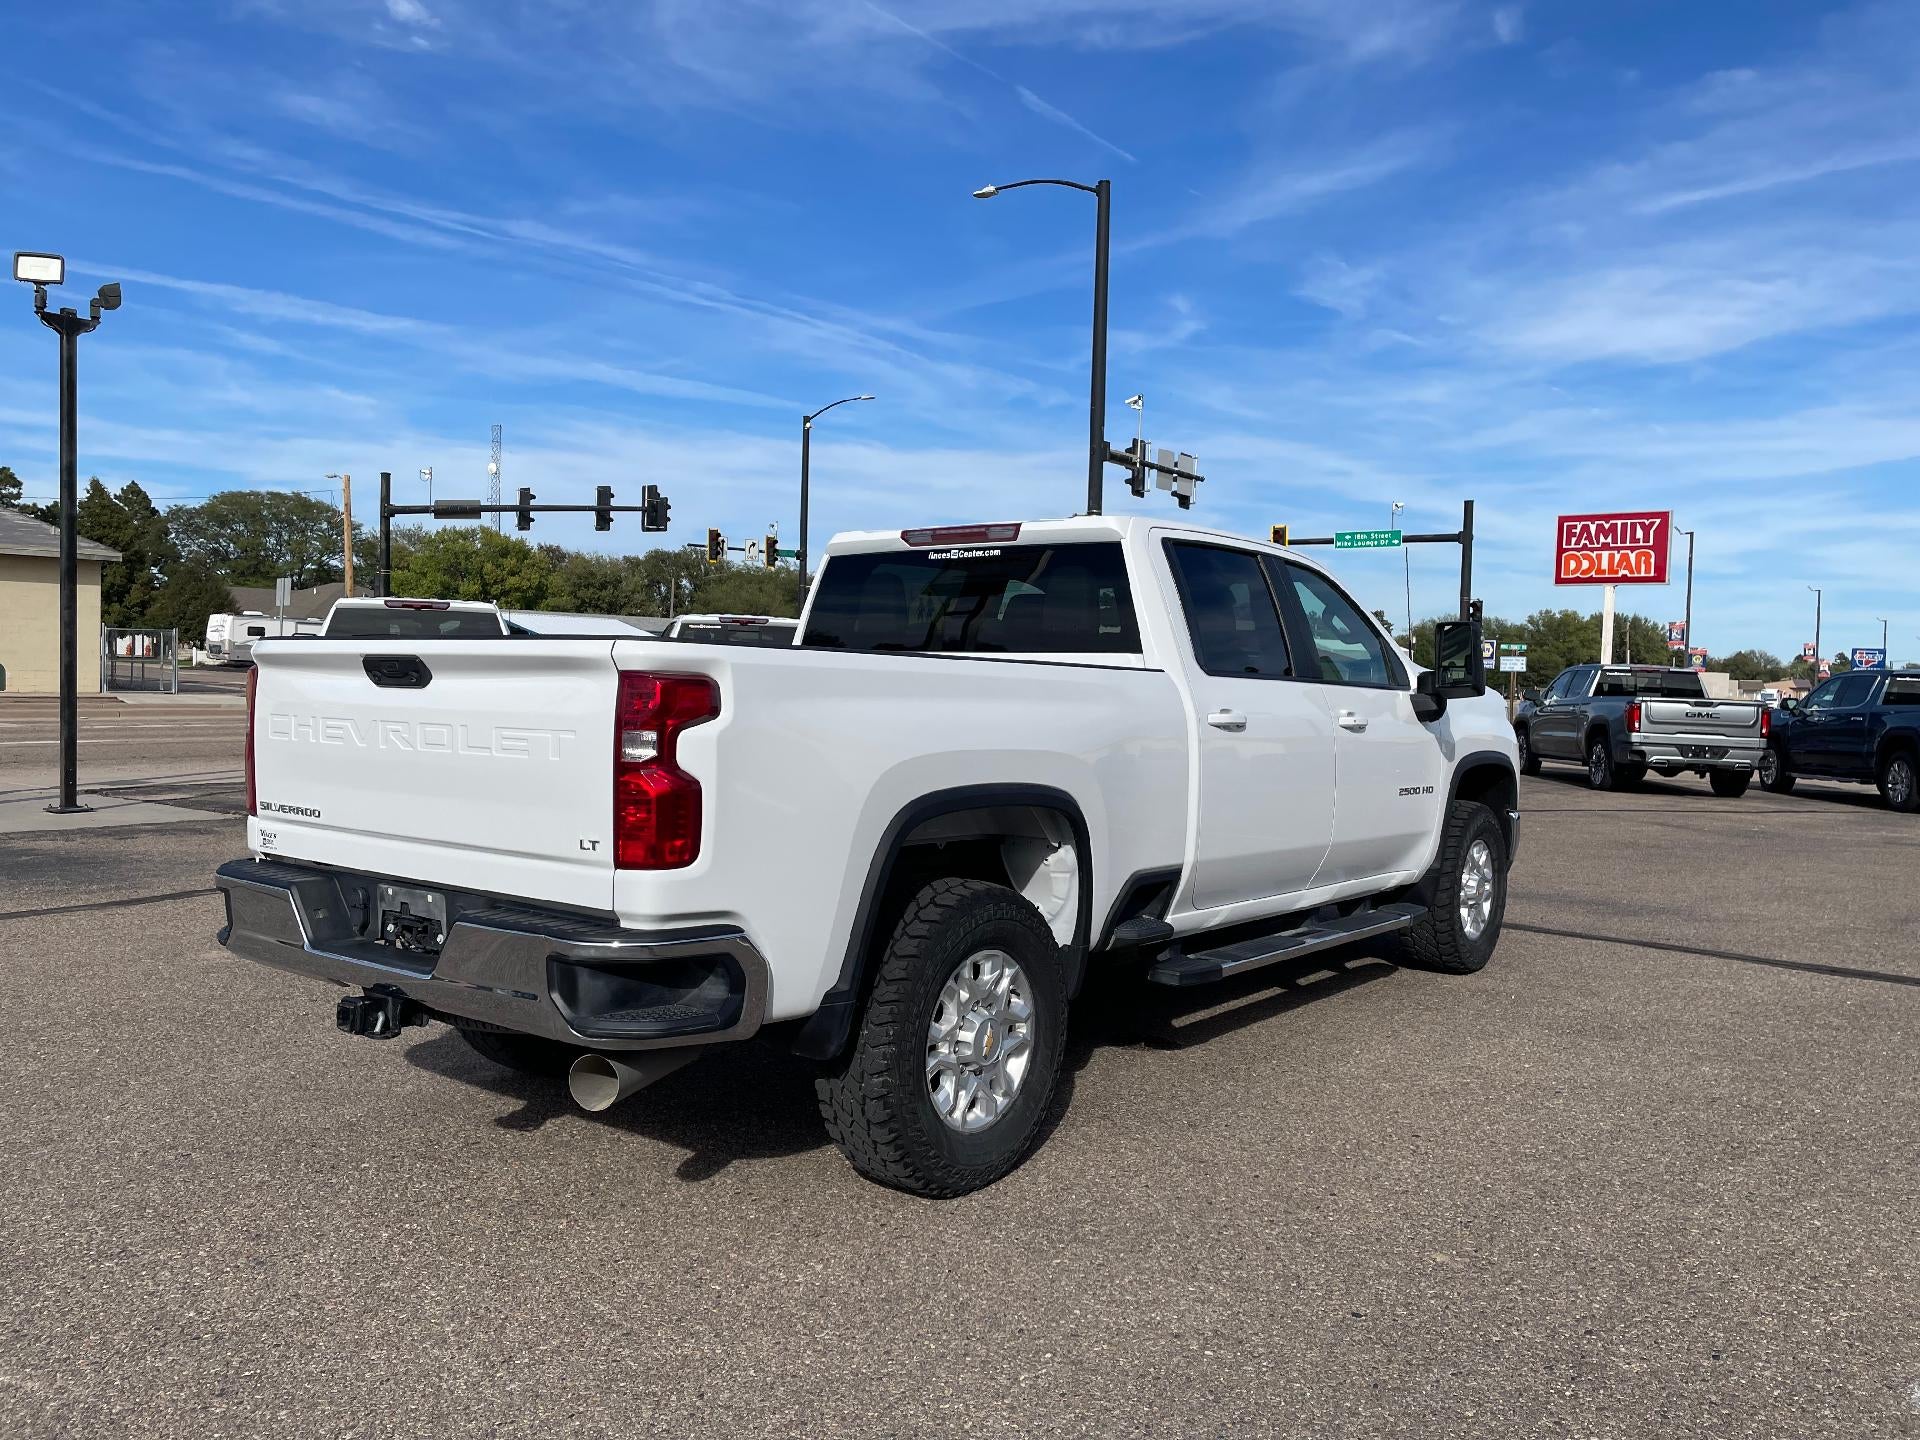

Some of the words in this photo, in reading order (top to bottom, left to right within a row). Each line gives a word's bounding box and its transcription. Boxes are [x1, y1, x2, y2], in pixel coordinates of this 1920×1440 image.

[1563, 519, 1661, 548] FAMILY
[1561, 549, 1655, 578] DOLLAR
[1685, 711, 1721, 719] GMC
[268, 713, 577, 760] CHEVROLET
[1399, 786, 1421, 796] 2500
[1422, 786, 1434, 795] HD
[259, 801, 321, 818] SILVERADO
[579, 839, 600, 851] LT
